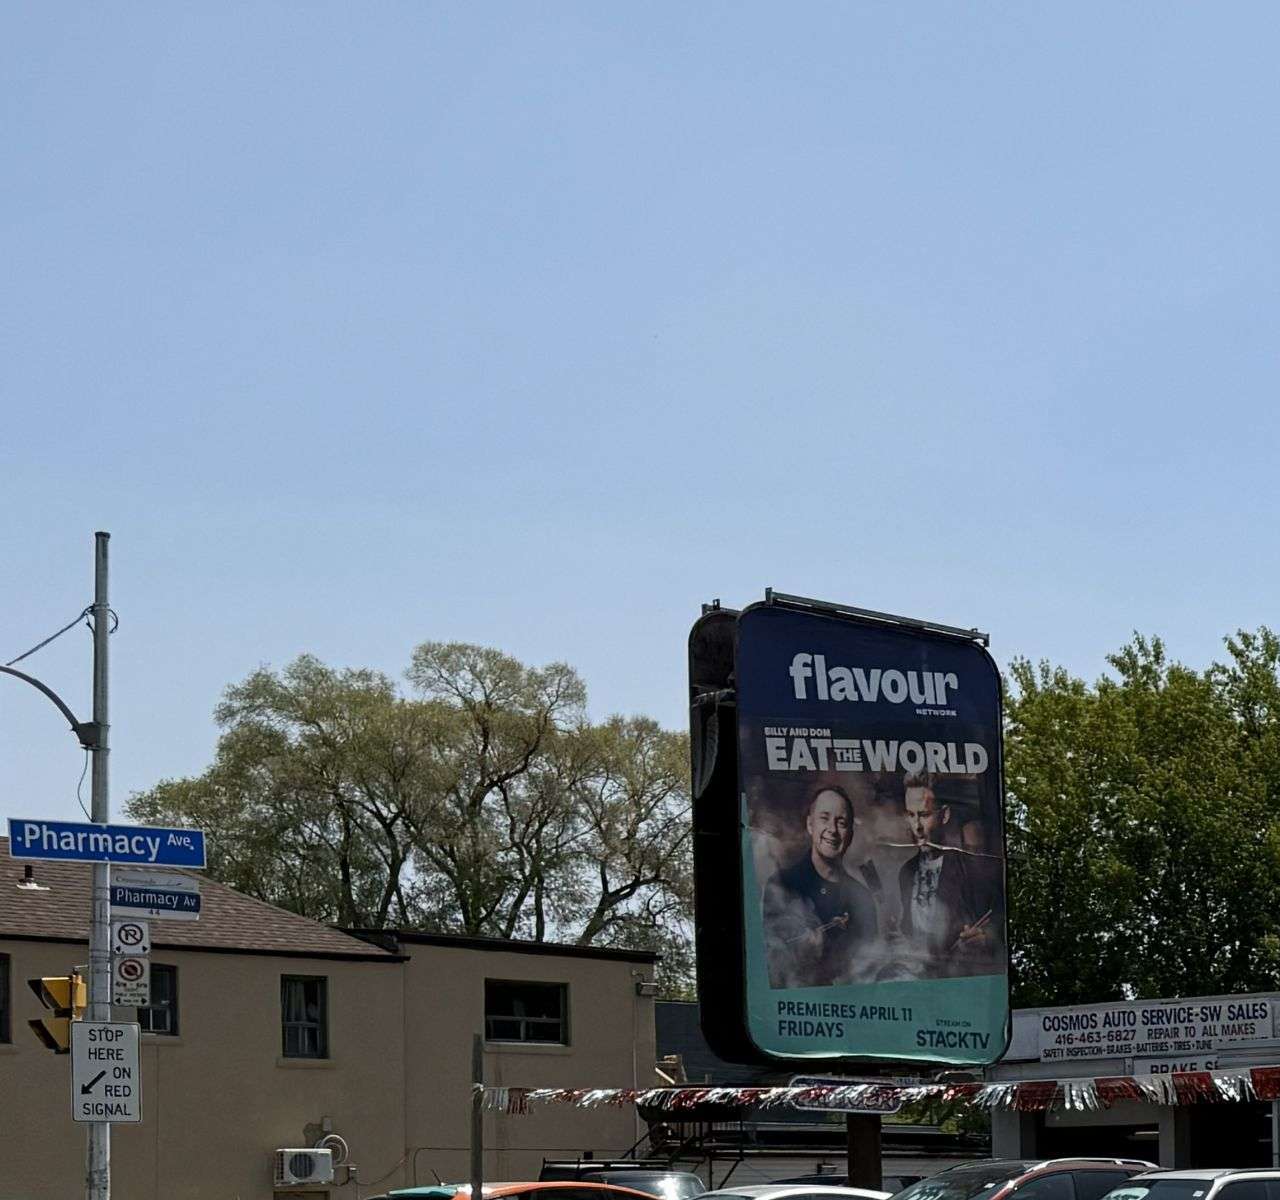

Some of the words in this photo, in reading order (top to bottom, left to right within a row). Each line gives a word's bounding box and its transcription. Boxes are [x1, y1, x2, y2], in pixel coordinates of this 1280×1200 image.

[789, 652, 959, 705] flavour
[916, 708, 958, 717] NETWORK
[764, 727, 788, 736] BILLY
[789, 728, 808, 737] AND
[810, 729, 831, 737] DOM
[766, 737, 832, 771] EAT
[835, 749, 864, 762] THE
[862, 739, 989, 774] WORLD
[24, 823, 160, 862] Pharmacy
[116, 888, 178, 908] Pharmacy
[183, 896, 196, 906] Av
[778, 1001, 856, 1019] PREMIERES
[860, 1006, 899, 1021] APRIL
[901, 1008, 912, 1022] 11
[1042, 1013, 1098, 1032] COSMOS
[1102, 1010, 1137, 1028] AUTO
[1141, 1005, 1221, 1026] SERVICE-SW
[1227, 1003, 1268, 1021] SALES
[88, 1029, 124, 1041] STOP
[778, 1020, 844, 1038] FRIDAYS
[1055, 1029, 1137, 1045] 416-463-6827
[1147, 1027, 1179, 1040] REPAIR
[1184, 1025, 1196, 1038] TO
[1201, 1023, 1218, 1037] ALL
[1221, 1022, 1256, 1036] MAKES
[916, 1029, 990, 1049] STACKTV
[88, 1047, 124, 1060] HERE
[113, 1066, 131, 1079] ON
[105, 1084, 131, 1097] RED
[83, 1103, 132, 1116] SIGNAL
